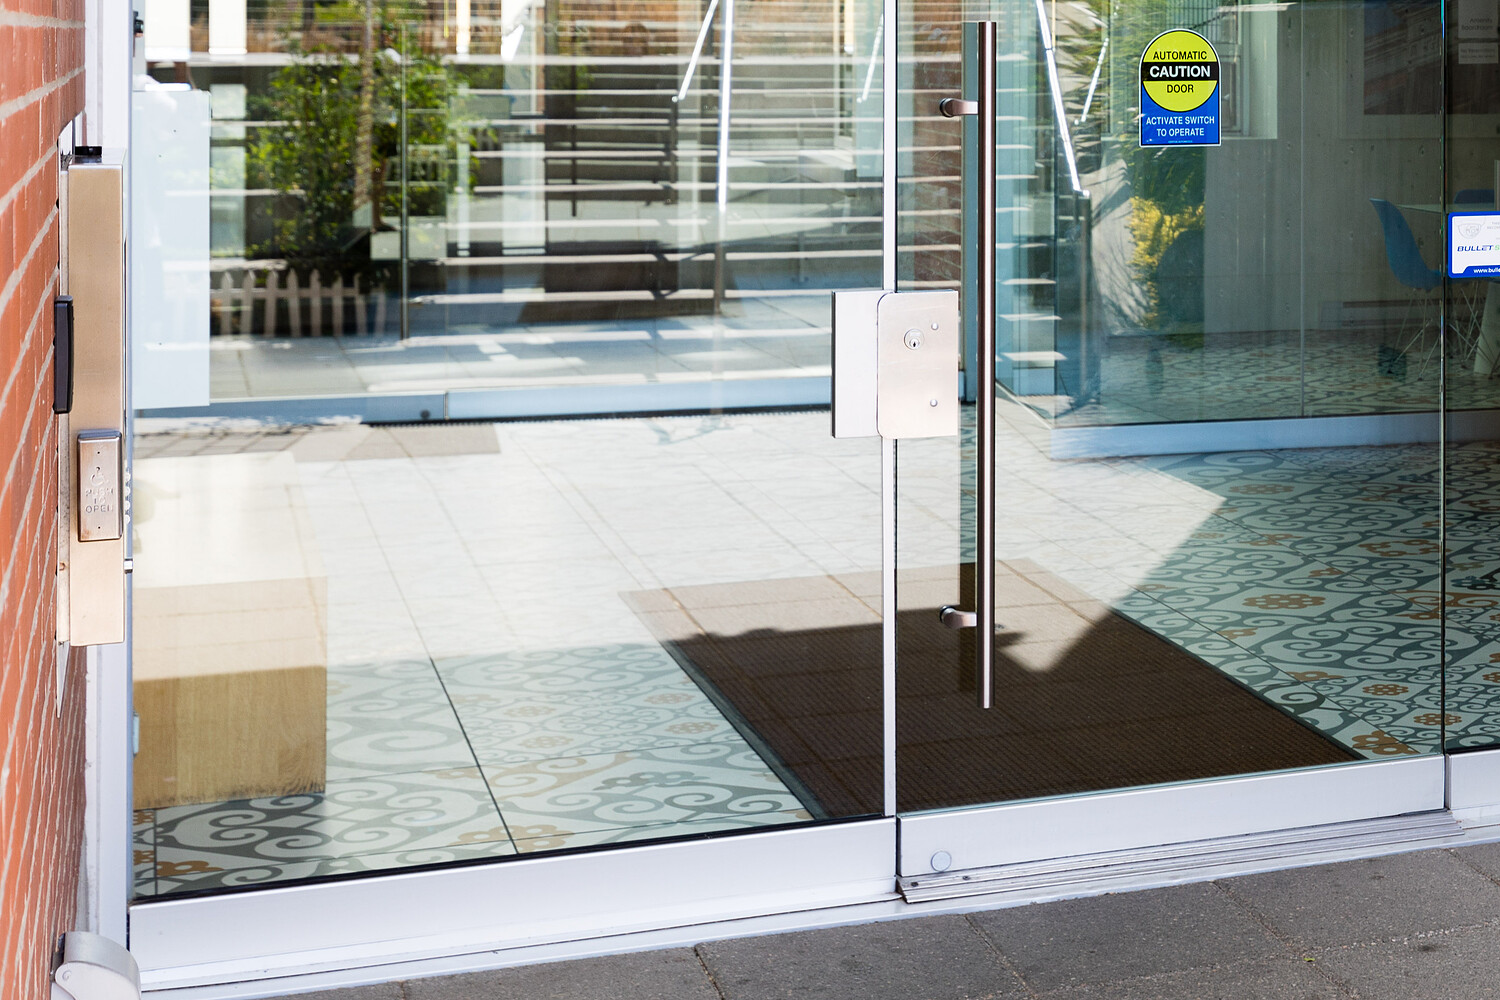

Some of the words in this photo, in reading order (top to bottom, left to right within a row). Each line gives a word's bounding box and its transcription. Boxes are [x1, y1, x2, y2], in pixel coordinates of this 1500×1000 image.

[1153, 51, 1207, 60] AUTOMATIC
[1149, 65, 1211, 78] CAUTION
[1166, 84, 1194, 93] DOOR
[1146, 116, 1183, 125] ACTIVATE
[1184, 115, 1215, 125] SWITCH
[1156, 128, 1168, 137] TO
[1168, 127, 1205, 137] OPERATE
[1457, 244, 1494, 252] BULLET
[85, 504, 114, 514] OPEN
